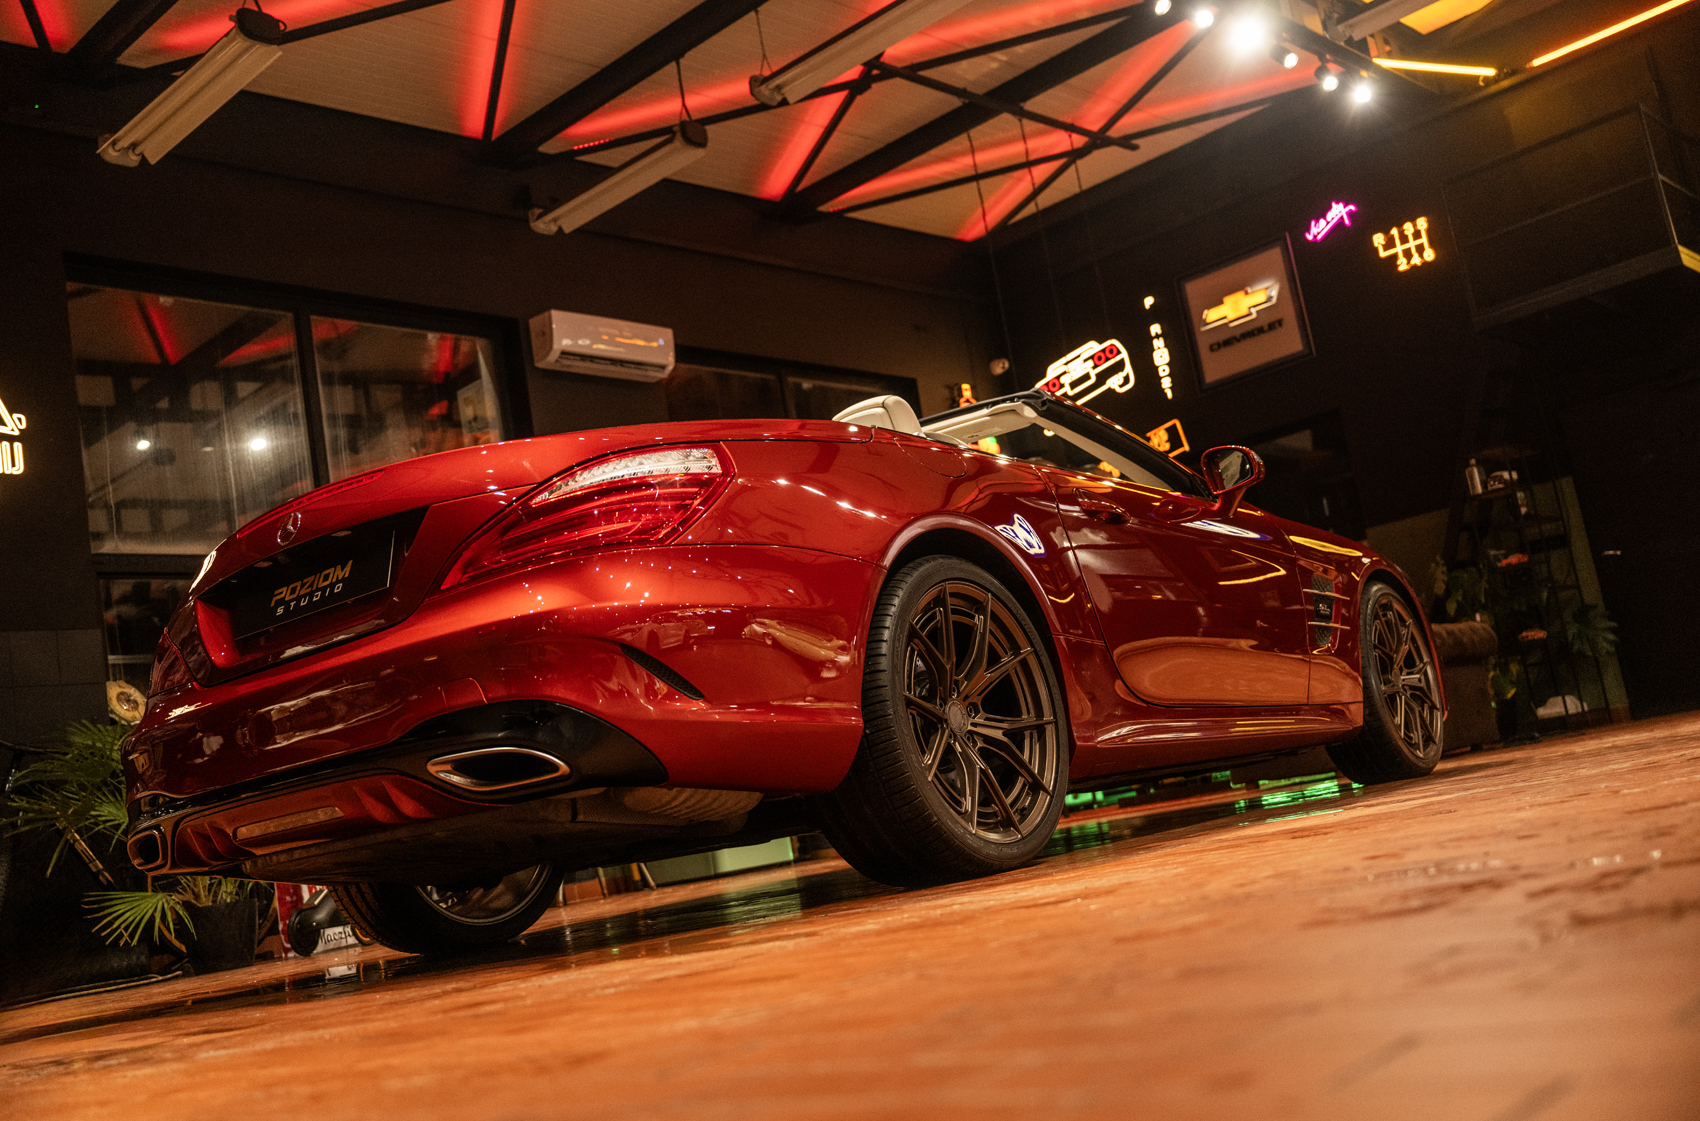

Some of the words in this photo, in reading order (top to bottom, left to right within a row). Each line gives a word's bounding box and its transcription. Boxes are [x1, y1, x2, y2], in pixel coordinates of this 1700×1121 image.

[1372, 232, 1386, 247] R
[1403, 221, 1415, 235] 3
[1209, 318, 1283, 352] CHEVROLET
[270, 559, 353, 607] POZIOM
[276, 582, 343, 616] STUDIO
[319, 925, 352, 945] Maczfi
